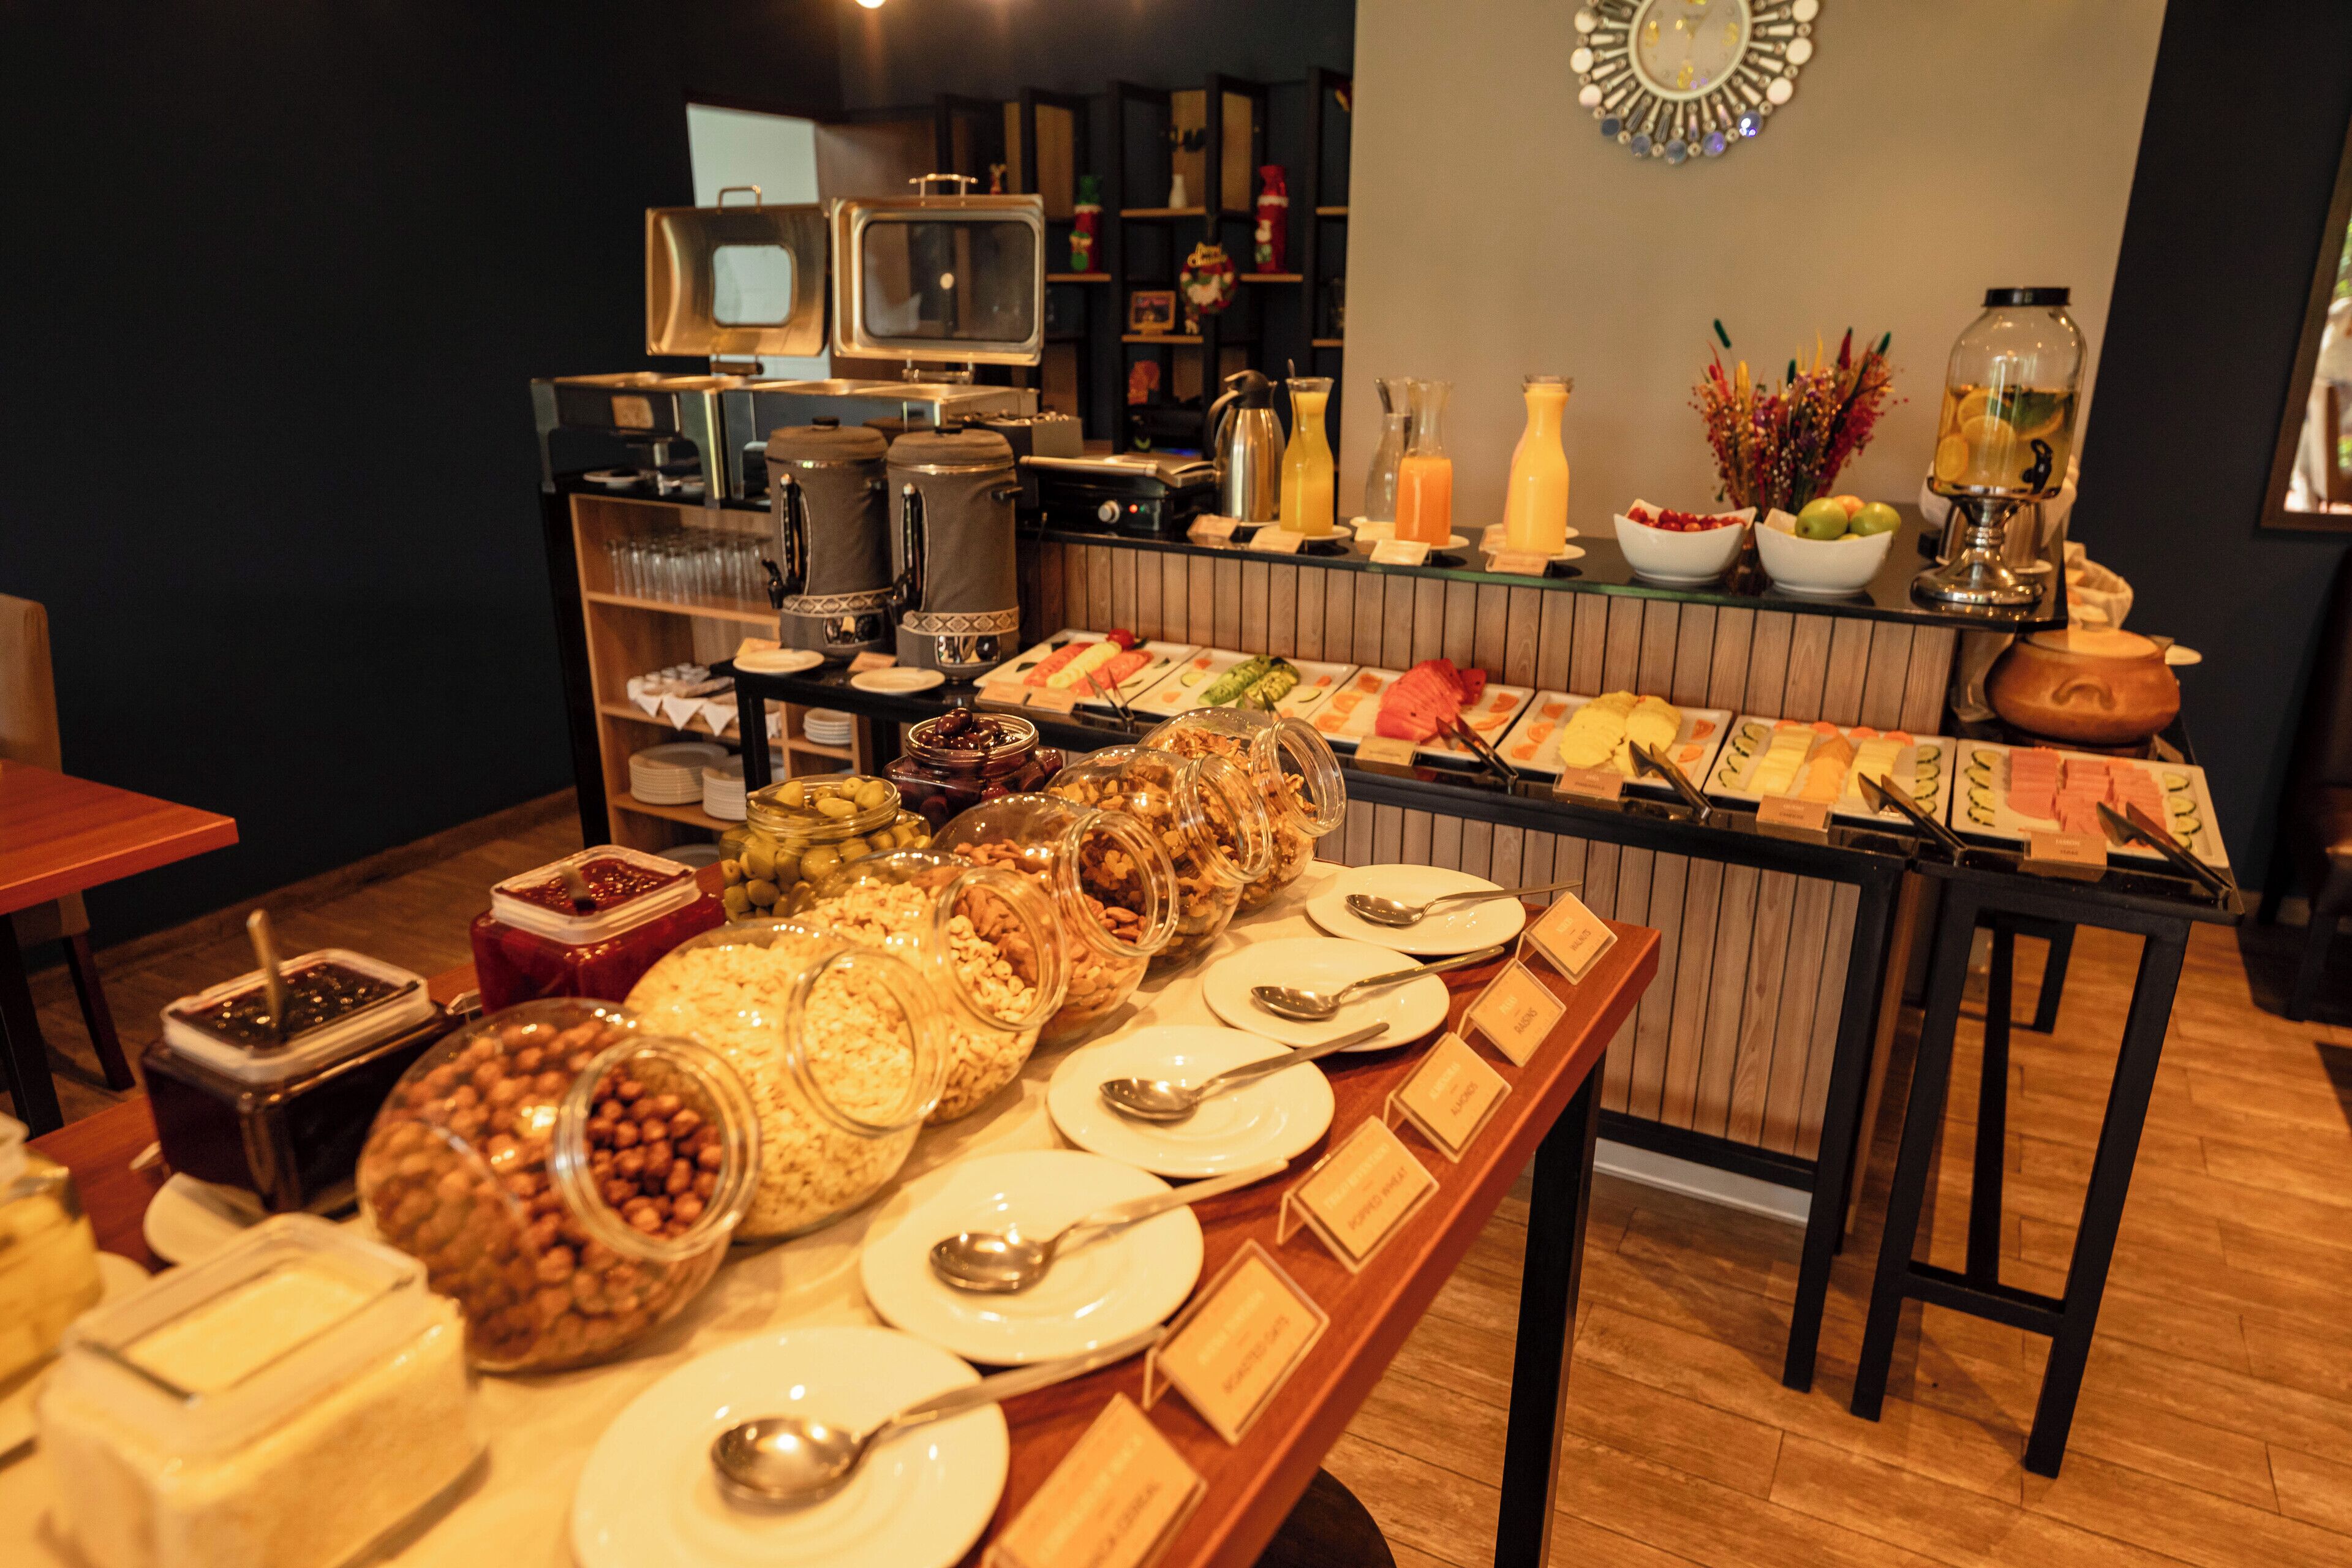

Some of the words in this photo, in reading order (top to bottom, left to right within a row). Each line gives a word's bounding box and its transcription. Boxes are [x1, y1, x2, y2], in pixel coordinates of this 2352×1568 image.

[1569, 929, 1591, 951] WALNUTS
[1514, 1007, 1537, 1035] RAISINS
[1449, 1080, 1478, 1115] ALMONDS
[1346, 1194, 1382, 1230] POPPED
[1379, 1166, 1409, 1197] WHEAT
[1263, 1313, 1290, 1344] OATS
